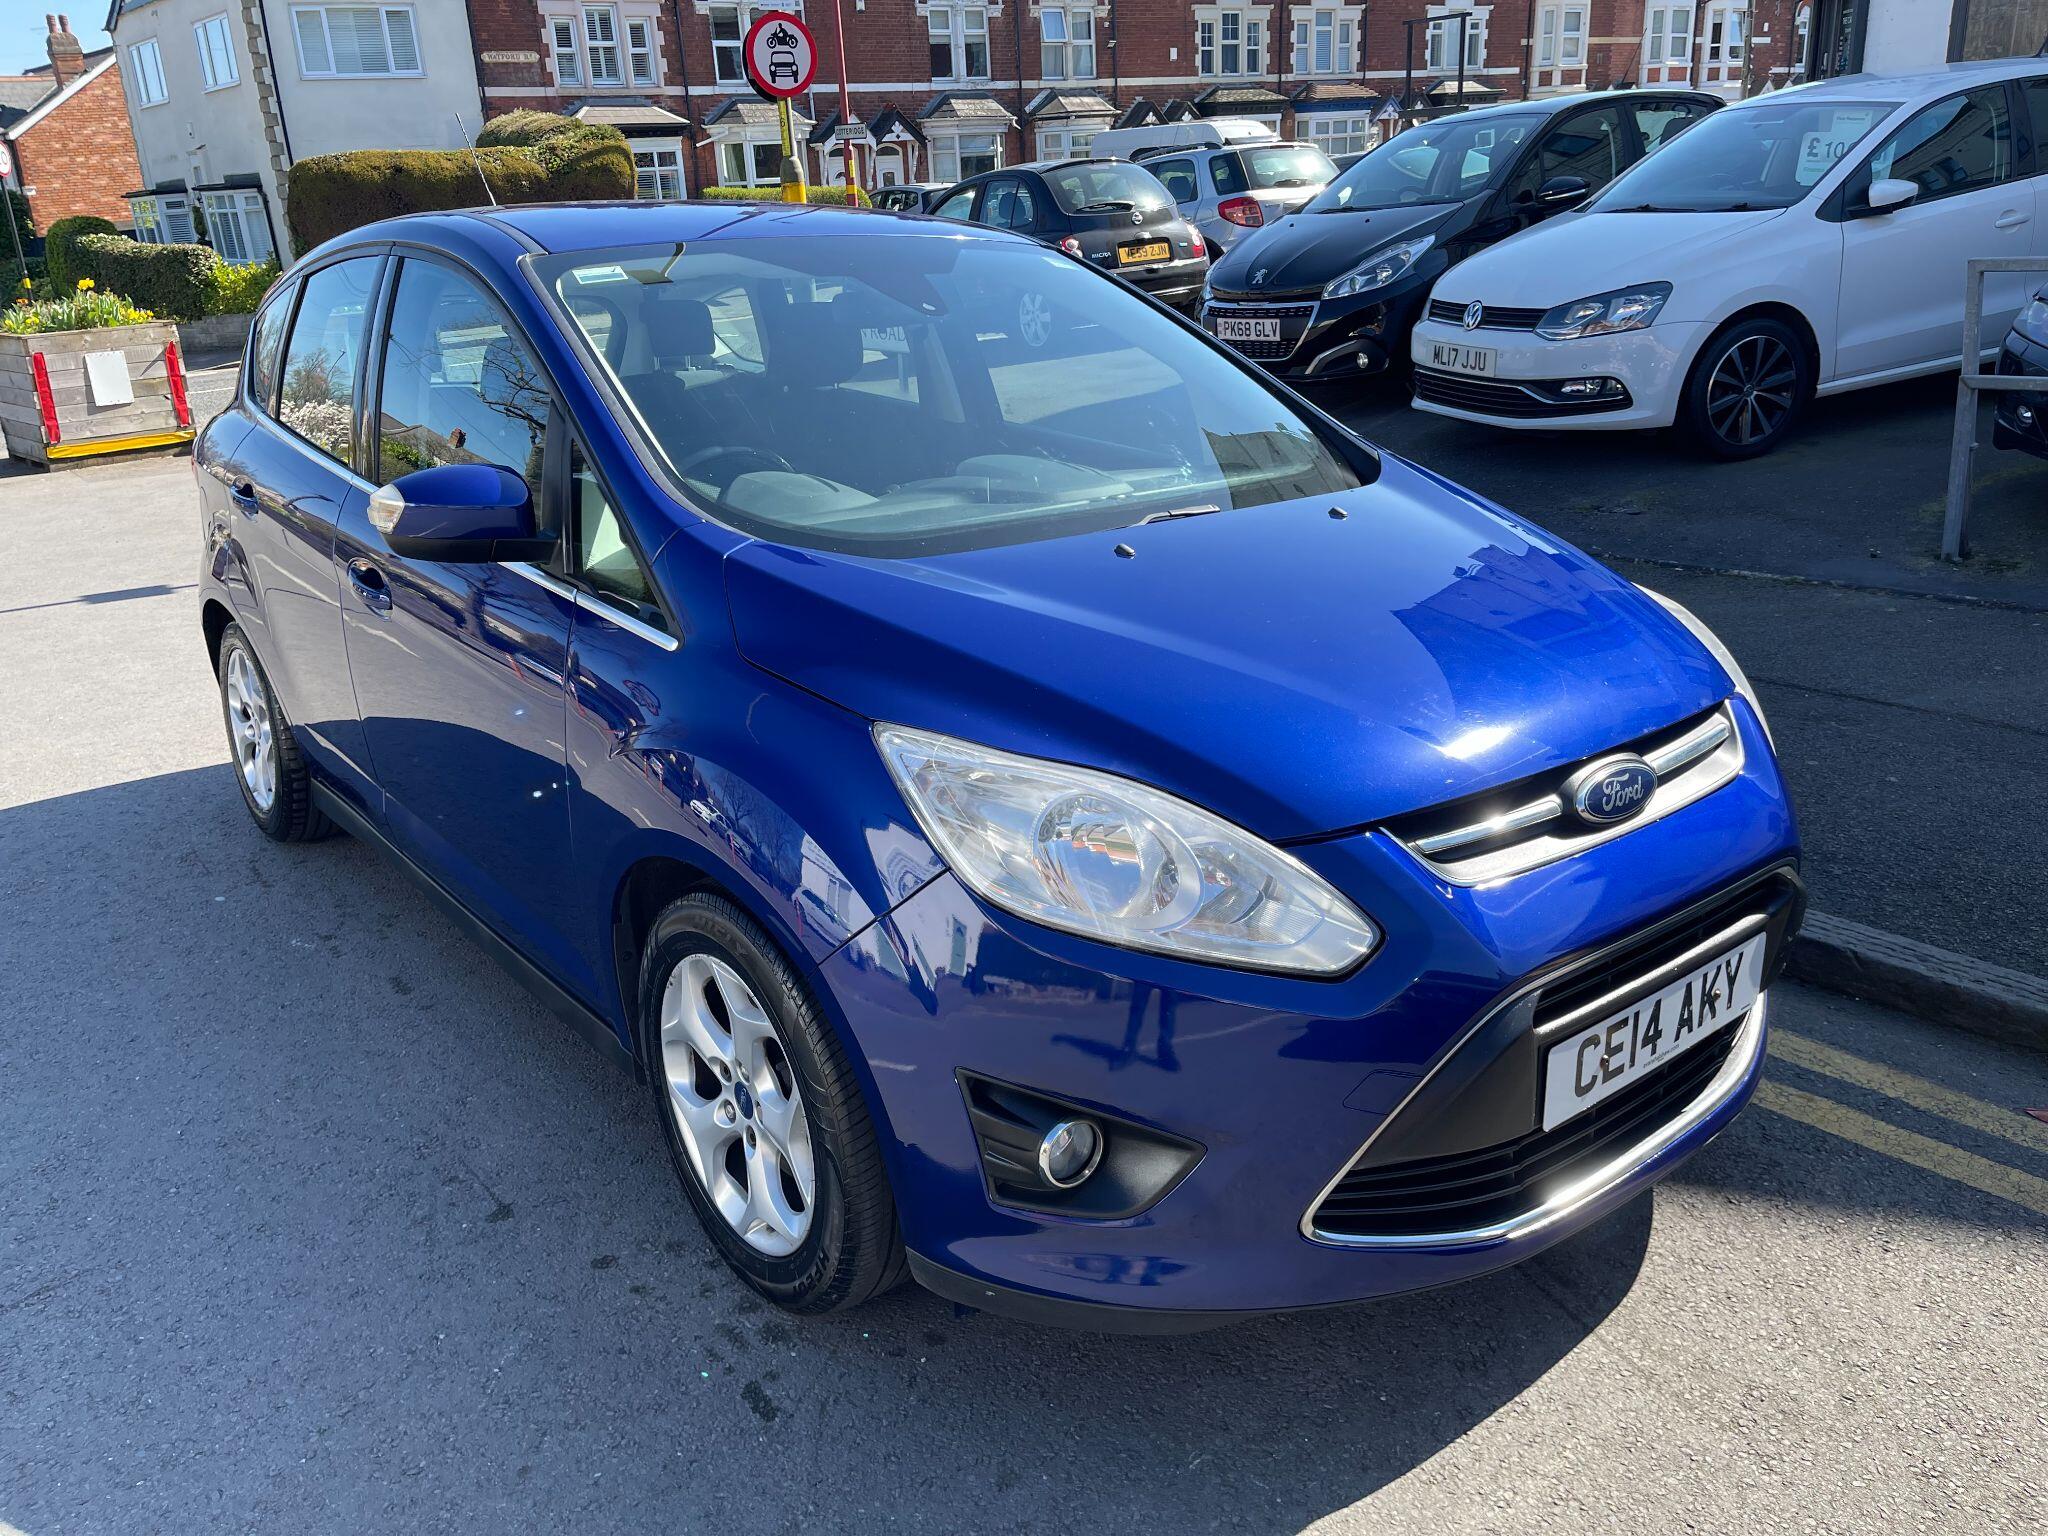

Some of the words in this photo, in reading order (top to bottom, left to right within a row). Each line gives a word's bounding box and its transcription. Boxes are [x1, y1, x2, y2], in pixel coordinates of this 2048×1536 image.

[1223, 320, 1252, 337] PK68
[1254, 321, 1278, 338] GLV
[1433, 344, 1459, 367] ML17
[1461, 349, 1487, 371] JJU
[1602, 772, 1644, 812] Ford
[1574, 998, 1663, 1098] CE14
[1674, 951, 1744, 1043] AKY
